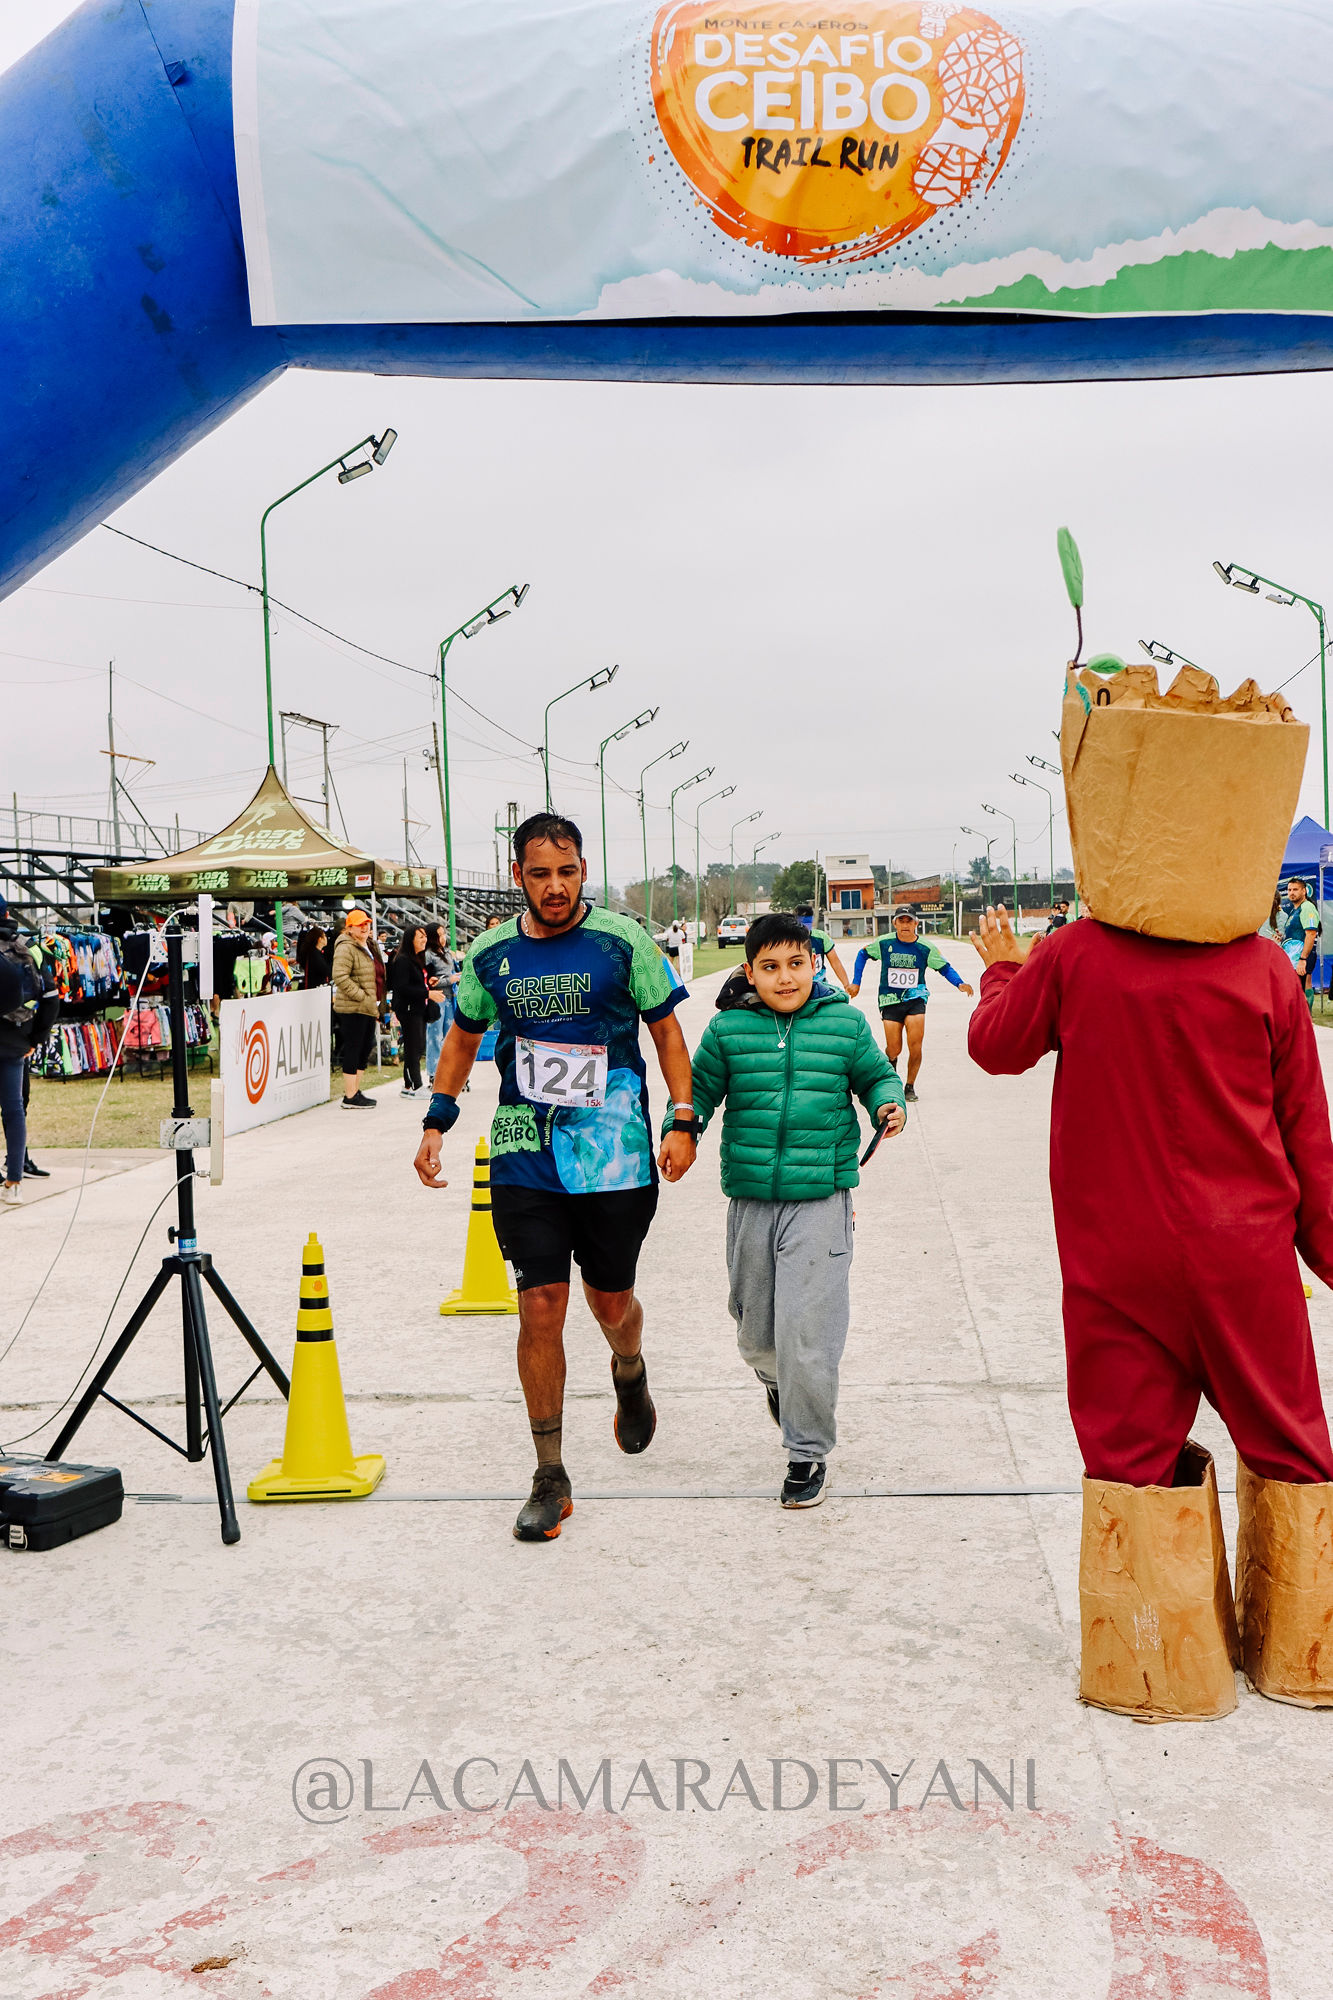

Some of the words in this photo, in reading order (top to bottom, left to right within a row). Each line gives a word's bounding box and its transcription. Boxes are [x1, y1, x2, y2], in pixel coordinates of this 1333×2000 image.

[704, 18, 772, 30] MONTE
[778, 20, 869, 32] CASEROS
[694, 31, 933, 71] DESAFÍO
[694, 71, 931, 134] CEIBO
[741, 136, 831, 175] TRAIL
[839, 136, 900, 176] RUN
[505, 972, 591, 998] GREEN
[890, 972, 916, 985] 209
[507, 992, 591, 1019] TRAIL
[275, 1019, 324, 1079] ALMA
[521, 1052, 600, 1097] 124
[494, 1126, 536, 1146] CEIBO
